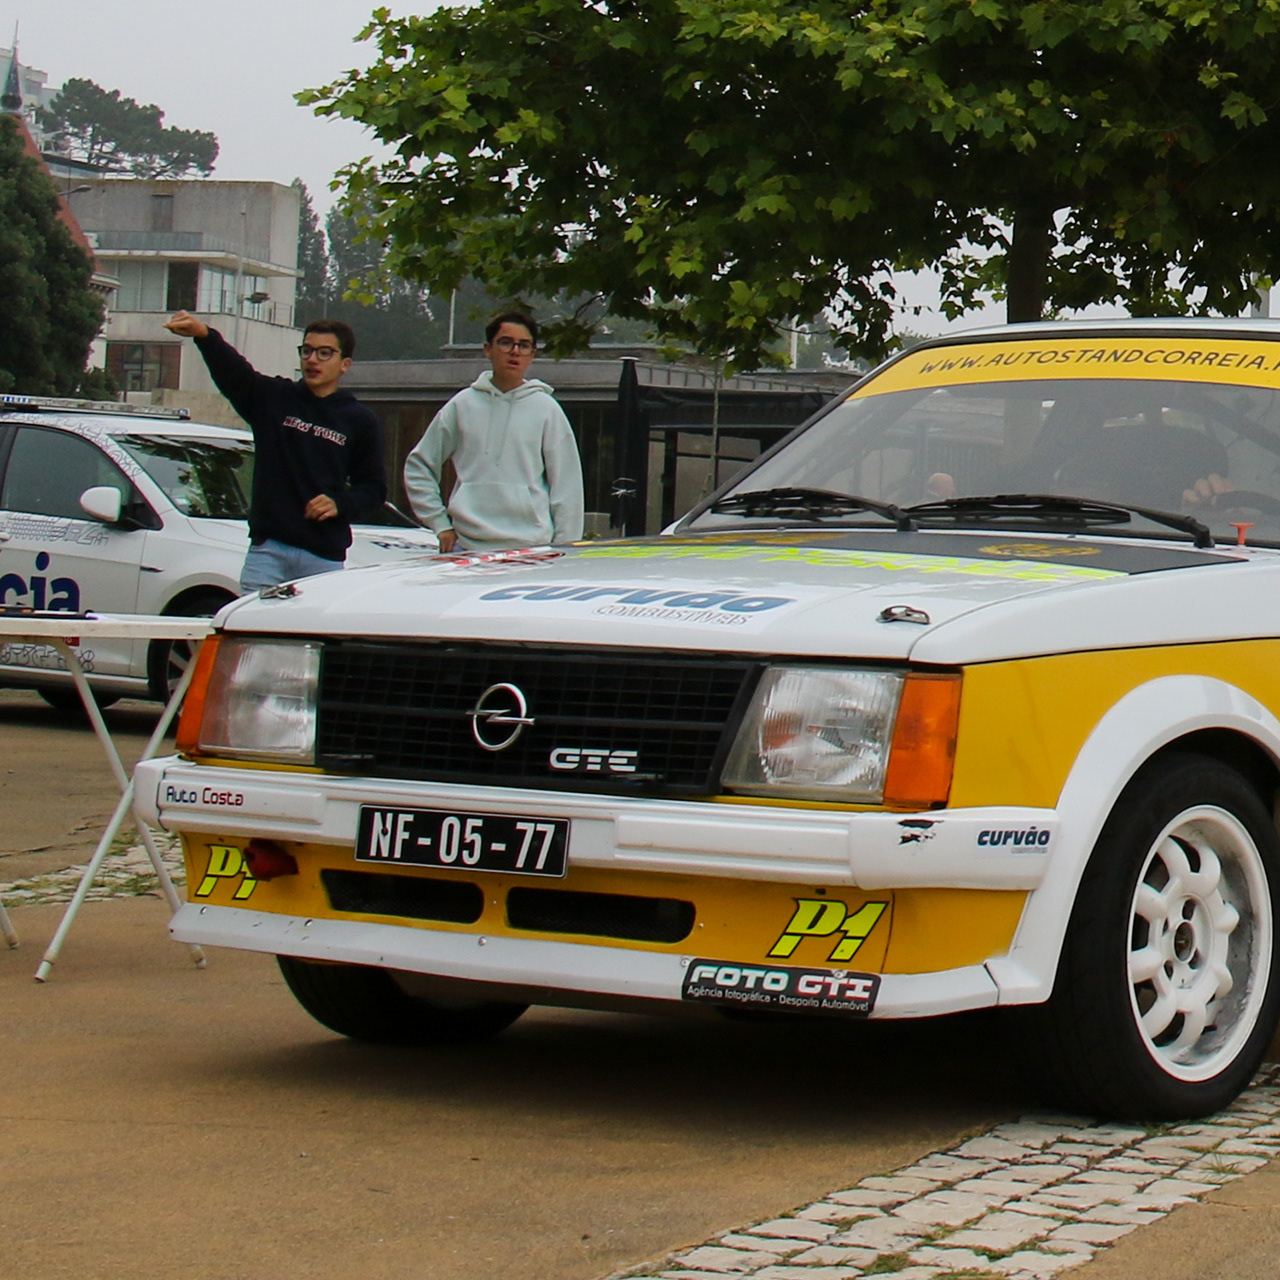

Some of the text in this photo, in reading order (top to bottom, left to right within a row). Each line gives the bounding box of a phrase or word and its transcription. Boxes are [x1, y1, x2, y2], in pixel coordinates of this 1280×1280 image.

[283, 415, 347, 447] NEW YORK
[549, 747, 638, 772] GTE
[165, 785, 244, 807] Auto Costa
[368, 810, 557, 871] NF-05-77
[977, 825, 1051, 847] curvão
[765, 897, 891, 963] P1
[690, 965, 874, 1001] FOTO GTI
